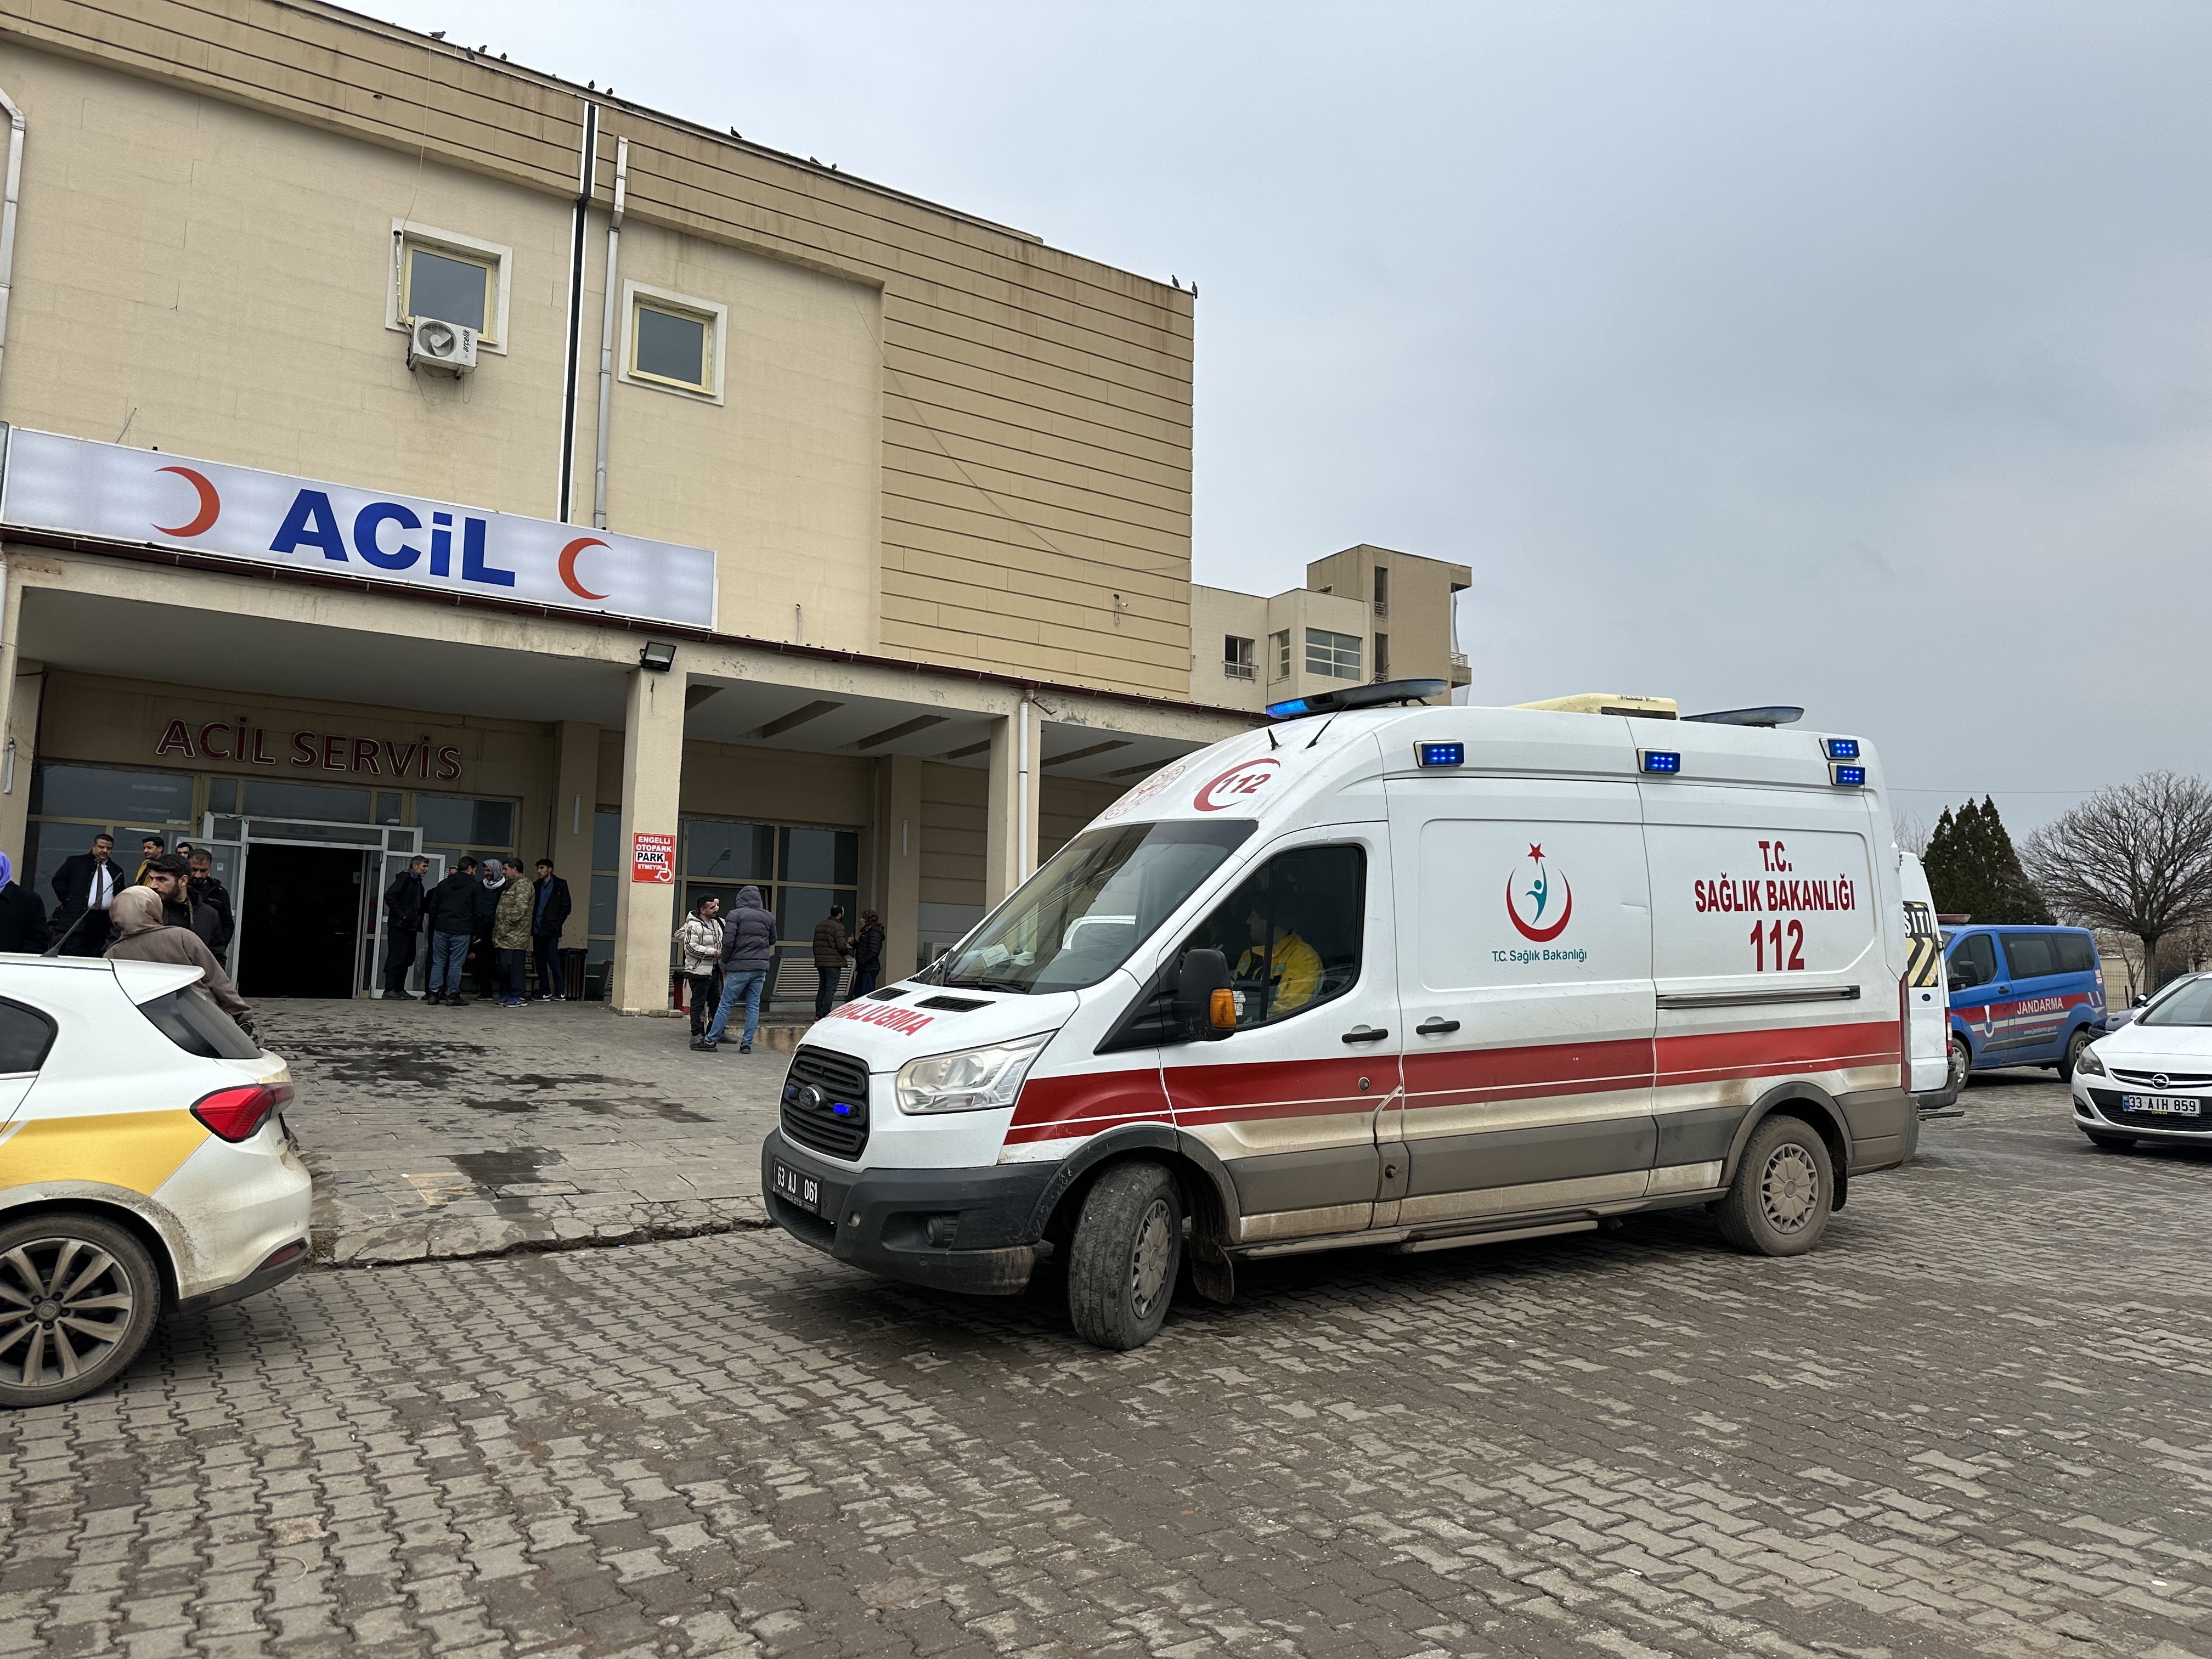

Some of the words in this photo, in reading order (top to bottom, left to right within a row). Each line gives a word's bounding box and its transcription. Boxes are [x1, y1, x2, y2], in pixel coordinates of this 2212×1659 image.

[462, 329, 471, 353] arçelik
[155, 716, 276, 765] ACİL
[291, 731, 461, 781] SERVİS
[1215, 774, 1272, 794] 112
[636, 844, 672, 852] OTOPARK
[637, 852, 664, 862] PARK
[1758, 840, 1793, 872] T.C.
[1695, 872, 1763, 912] SAĞLIK
[1766, 873, 1855, 911] BAKANLIĞI
[1492, 950, 1508, 962] T.C.
[1510, 950, 1541, 964] Sağlık
[1543, 949, 1587, 962] Bakanlığı
[1750, 919, 1805, 972] 112
[2017, 997, 2064, 1015] JANDARMA
[2129, 1097, 2142, 1108] 33
[2148, 1098, 2168, 1110] AIH
[2174, 1099, 2196, 1111] 859
[777, 1165, 785, 1187] 63
[788, 1171, 796, 1194] AJ
[804, 1179, 817, 1204] 061
